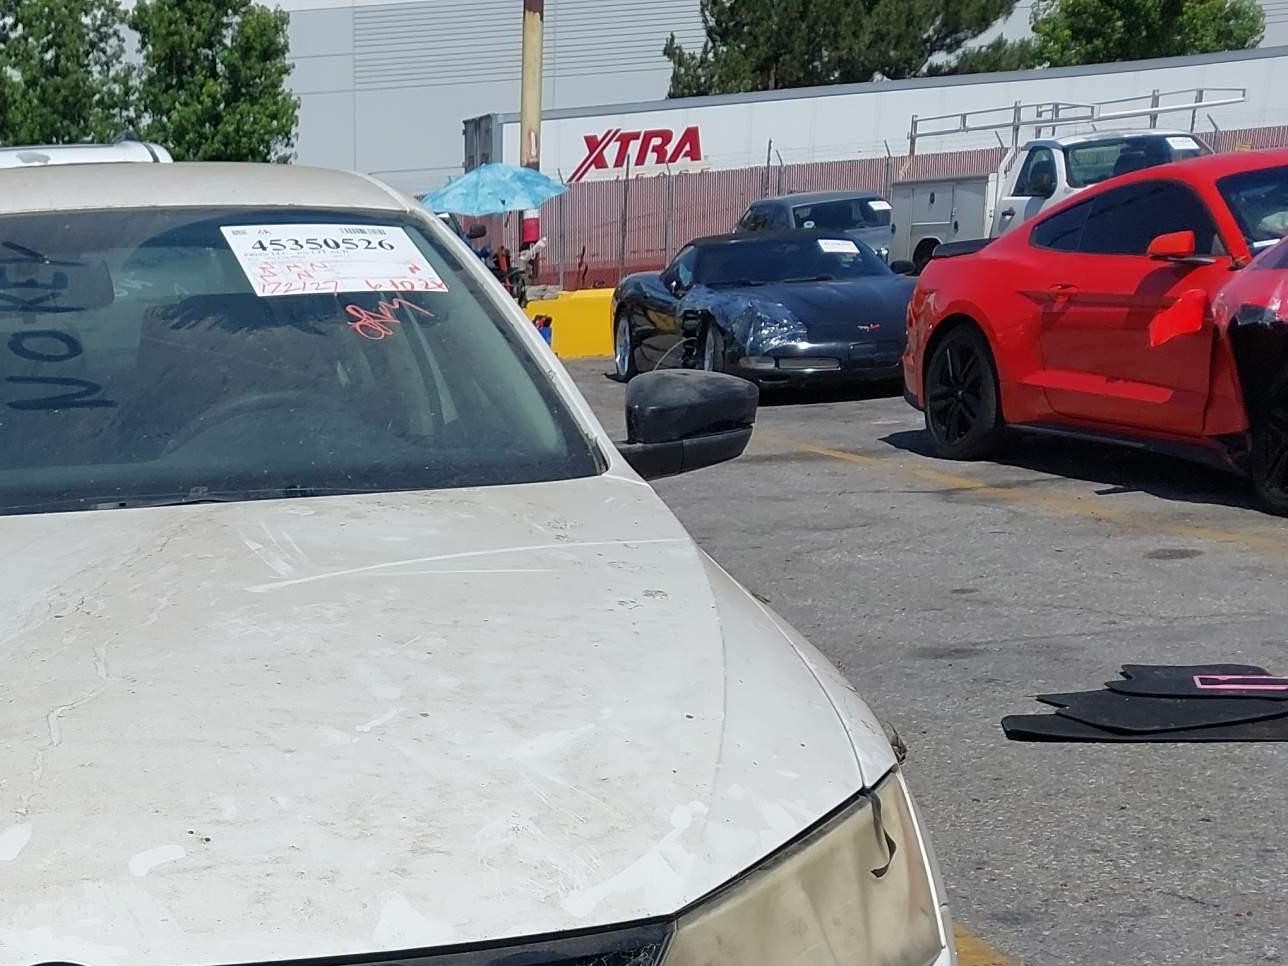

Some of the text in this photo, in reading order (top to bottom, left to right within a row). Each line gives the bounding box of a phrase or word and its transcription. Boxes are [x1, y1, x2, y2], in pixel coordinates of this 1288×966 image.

[567, 126, 702, 183] XTRA
[251, 238, 395, 252] 45350526
[5, 330, 119, 411] NO
